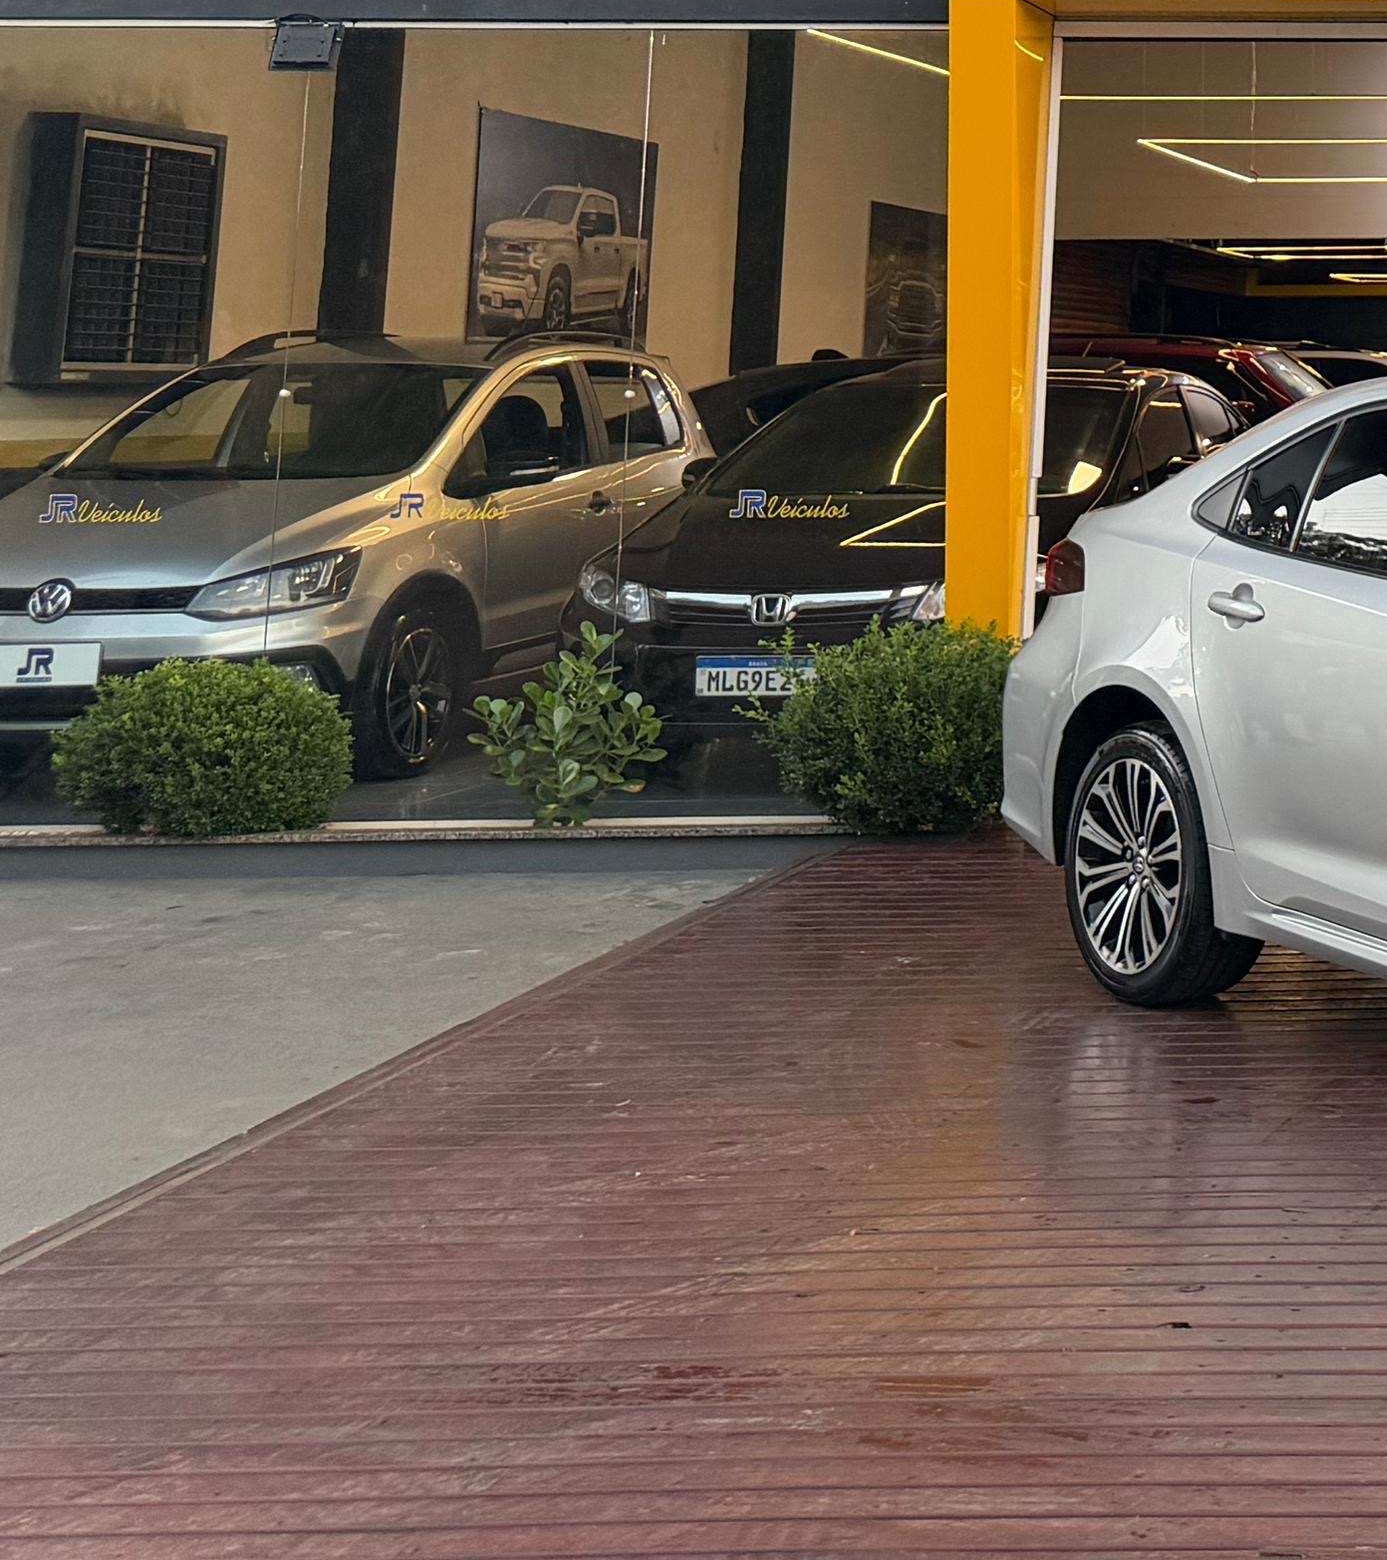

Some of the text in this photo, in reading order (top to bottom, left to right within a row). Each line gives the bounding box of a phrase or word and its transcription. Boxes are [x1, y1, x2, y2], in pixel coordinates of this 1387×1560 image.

[39, 493, 78, 523] JR
[390, 493, 424, 519] JR
[729, 489, 850, 519] JR Veículos
[17, 647, 54, 676] JR
[707, 670, 797, 692] MLG9E2
